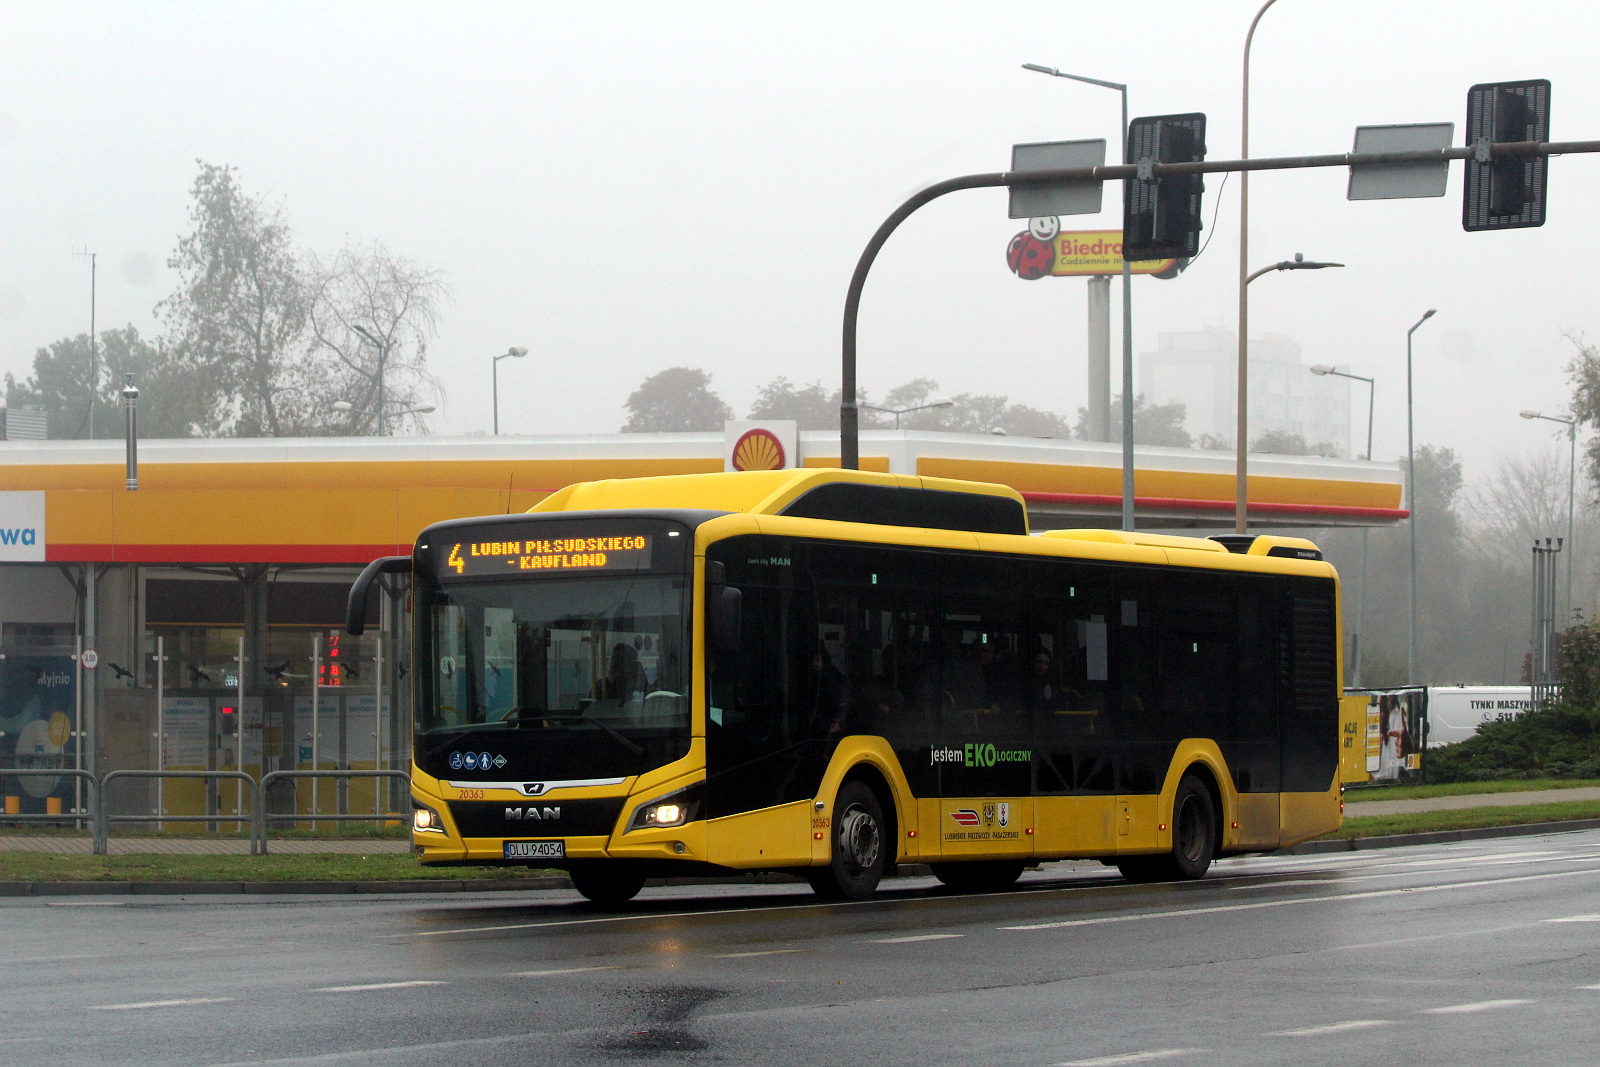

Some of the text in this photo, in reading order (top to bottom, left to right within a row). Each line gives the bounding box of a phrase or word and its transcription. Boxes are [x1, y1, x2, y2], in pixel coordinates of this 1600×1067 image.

[1060, 239, 1123, 255] Biedro
[1060, 256, 1110, 265] Codziennie
[448, 536, 645, 574] 4 LUBIN PIŁSUDSKIEGO
[520, 552, 608, 569] KAUFLAND
[770, 557, 791, 566] MAN
[38, 672, 70, 688] Myjnia
[1470, 700, 1494, 709] TYNKI
[930, 744, 963, 766] jestem
[459, 790, 484, 799] 20363
[505, 806, 561, 820] MAN
[812, 817, 830, 828] 20363
[944, 830, 1019, 840] LUBIŃSKIE PRZEWOZY PASAŻERSKIE
[509, 843, 562, 856] DLU 94054
